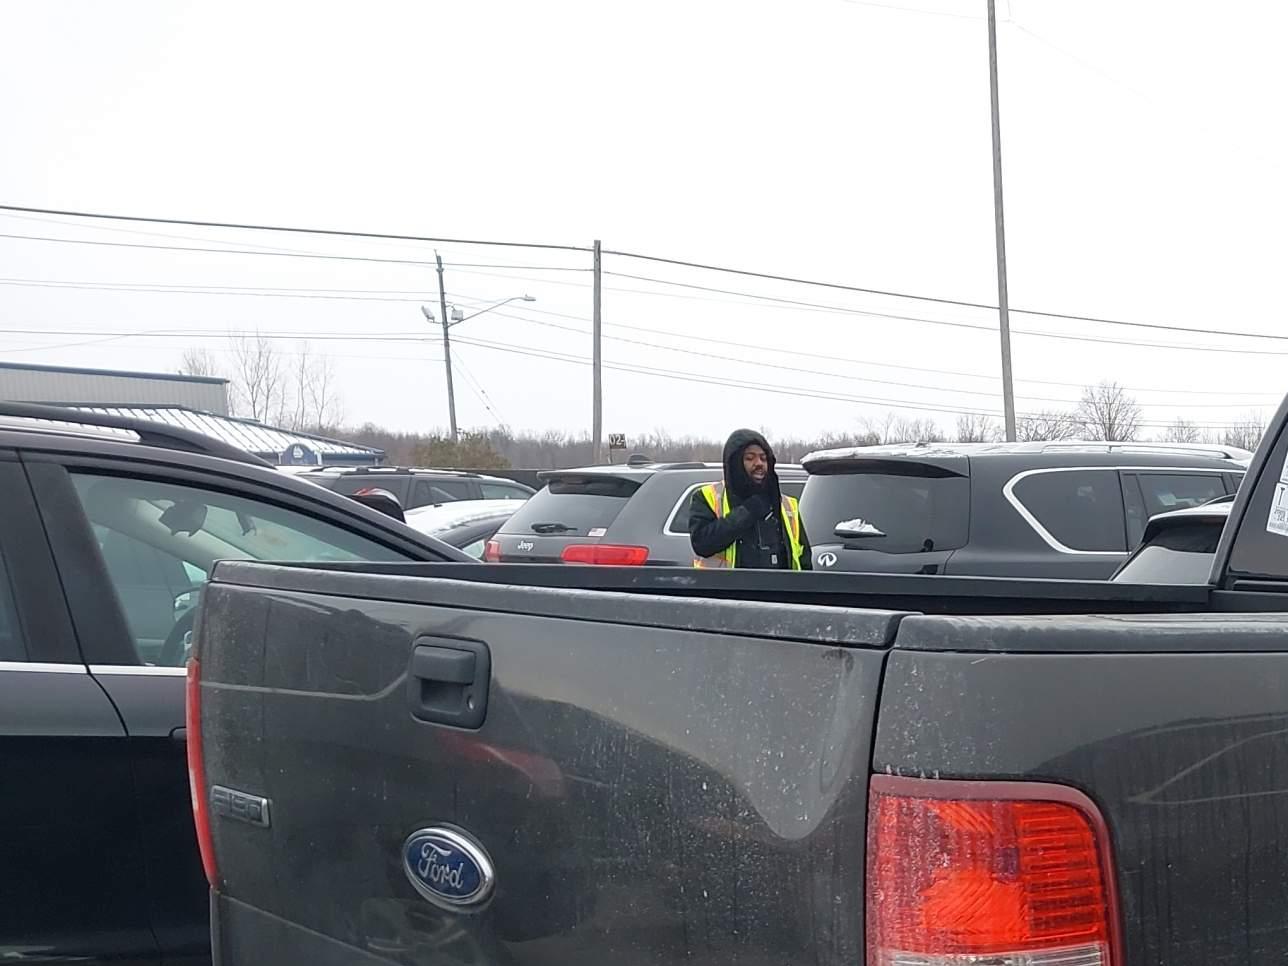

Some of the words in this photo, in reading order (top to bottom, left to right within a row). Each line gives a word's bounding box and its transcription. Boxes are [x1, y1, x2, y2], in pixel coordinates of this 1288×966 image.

[1277, 487, 1286, 506] T
[517, 540, 534, 551] Jeep
[418, 842, 465, 889] Ford
